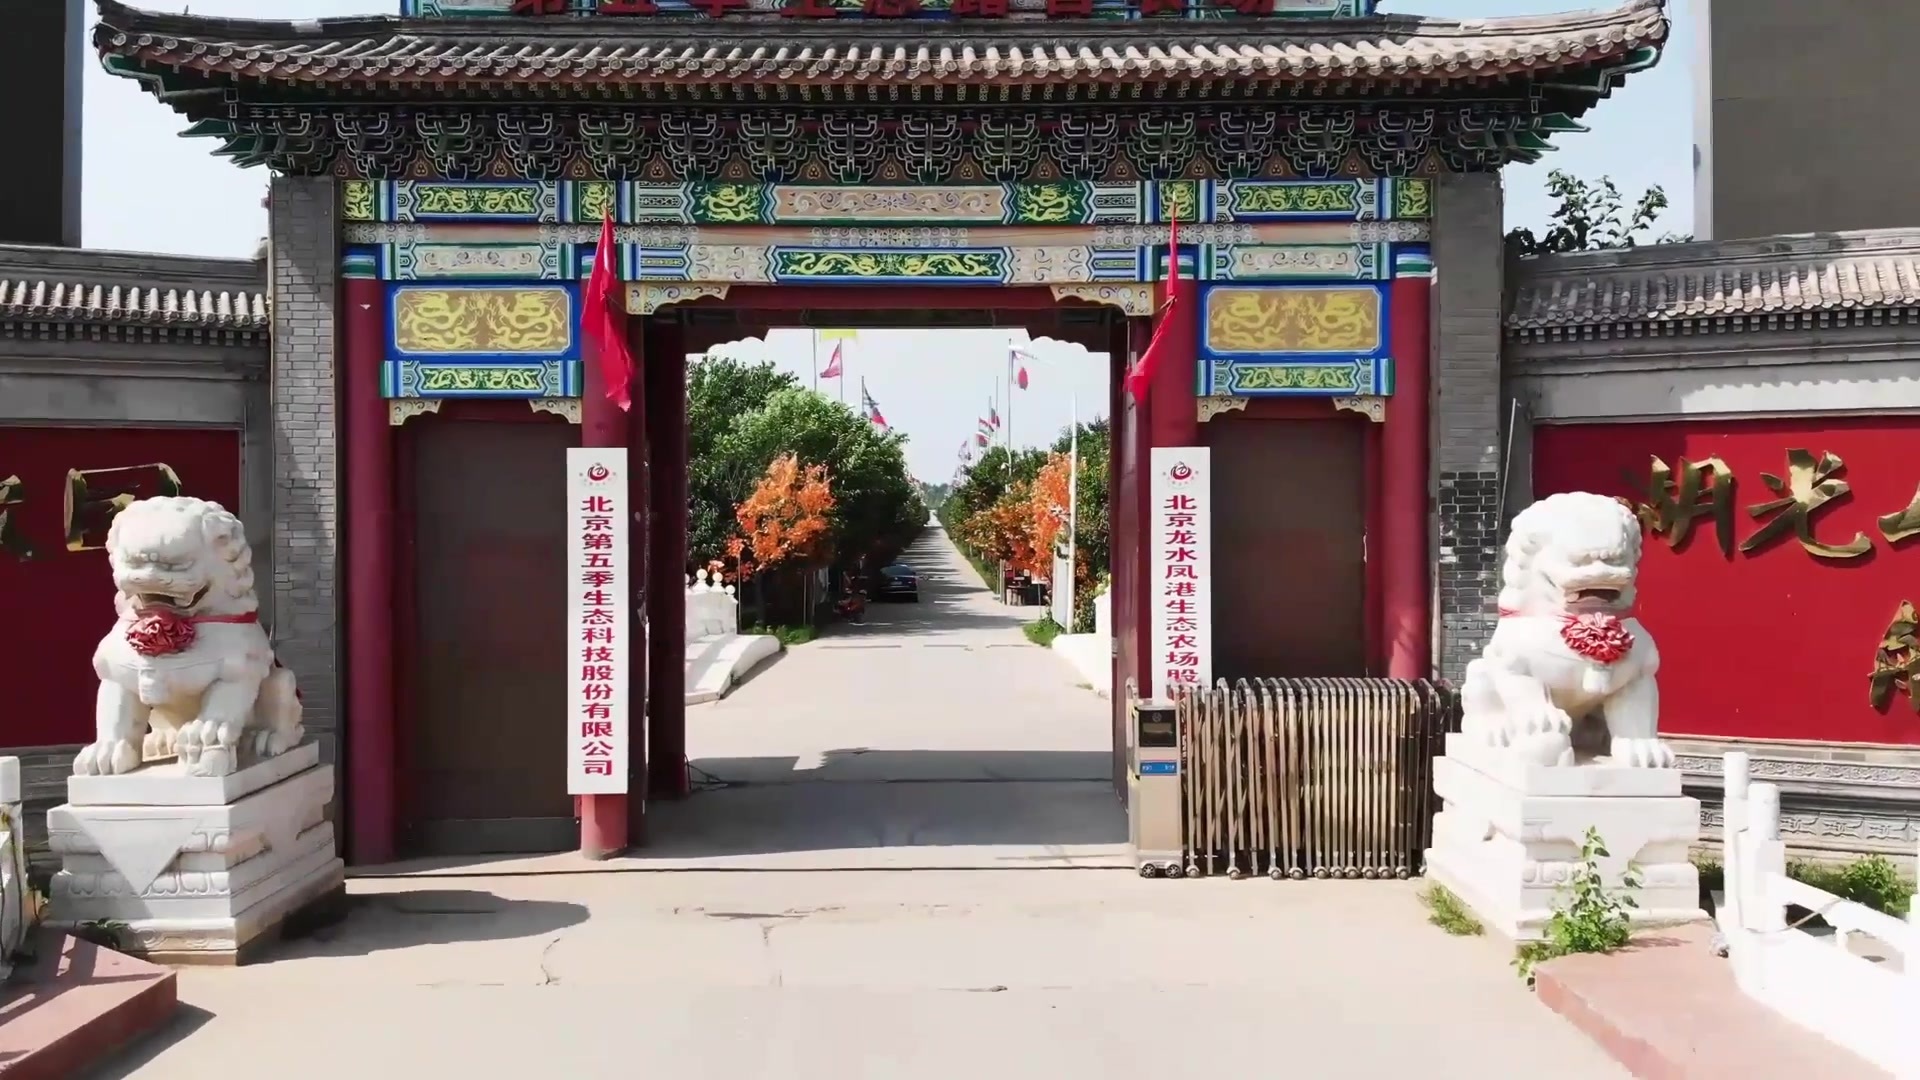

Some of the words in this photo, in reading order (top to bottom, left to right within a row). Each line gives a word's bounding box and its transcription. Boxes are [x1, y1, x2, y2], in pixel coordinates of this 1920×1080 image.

[581, 495, 614, 776] 北京第五季生态科技股份有限公司
